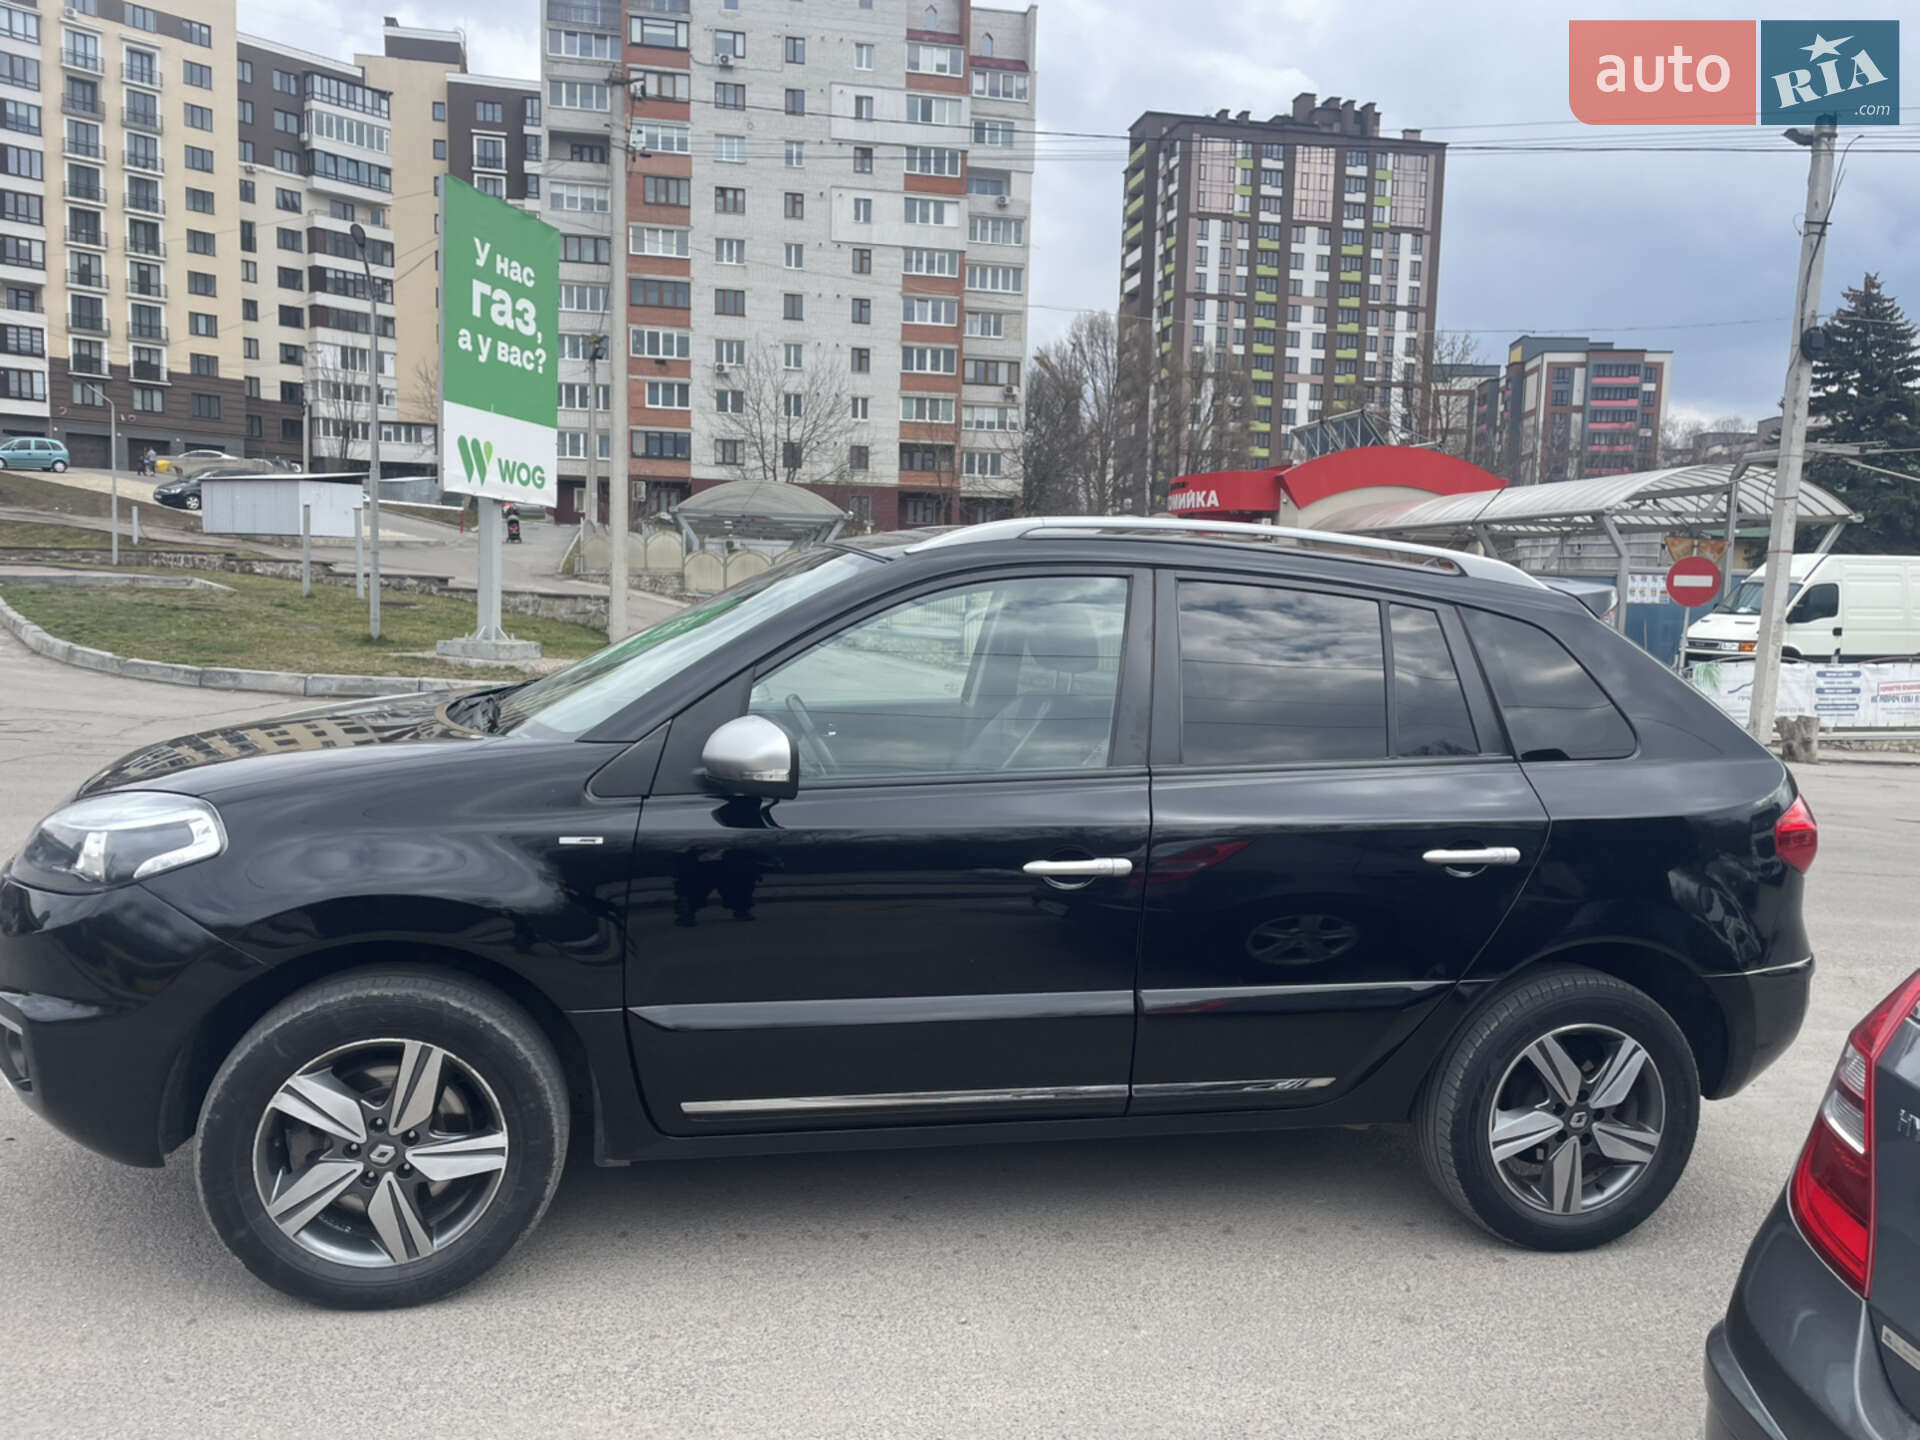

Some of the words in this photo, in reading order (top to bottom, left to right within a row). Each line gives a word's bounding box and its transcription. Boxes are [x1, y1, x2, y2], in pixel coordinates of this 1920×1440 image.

[496, 253, 536, 288] нас
[472, 278, 543, 345] газ,
[457, 327, 473, 352] а
[497, 340, 547, 374] вас?
[497, 457, 545, 489] WOG
